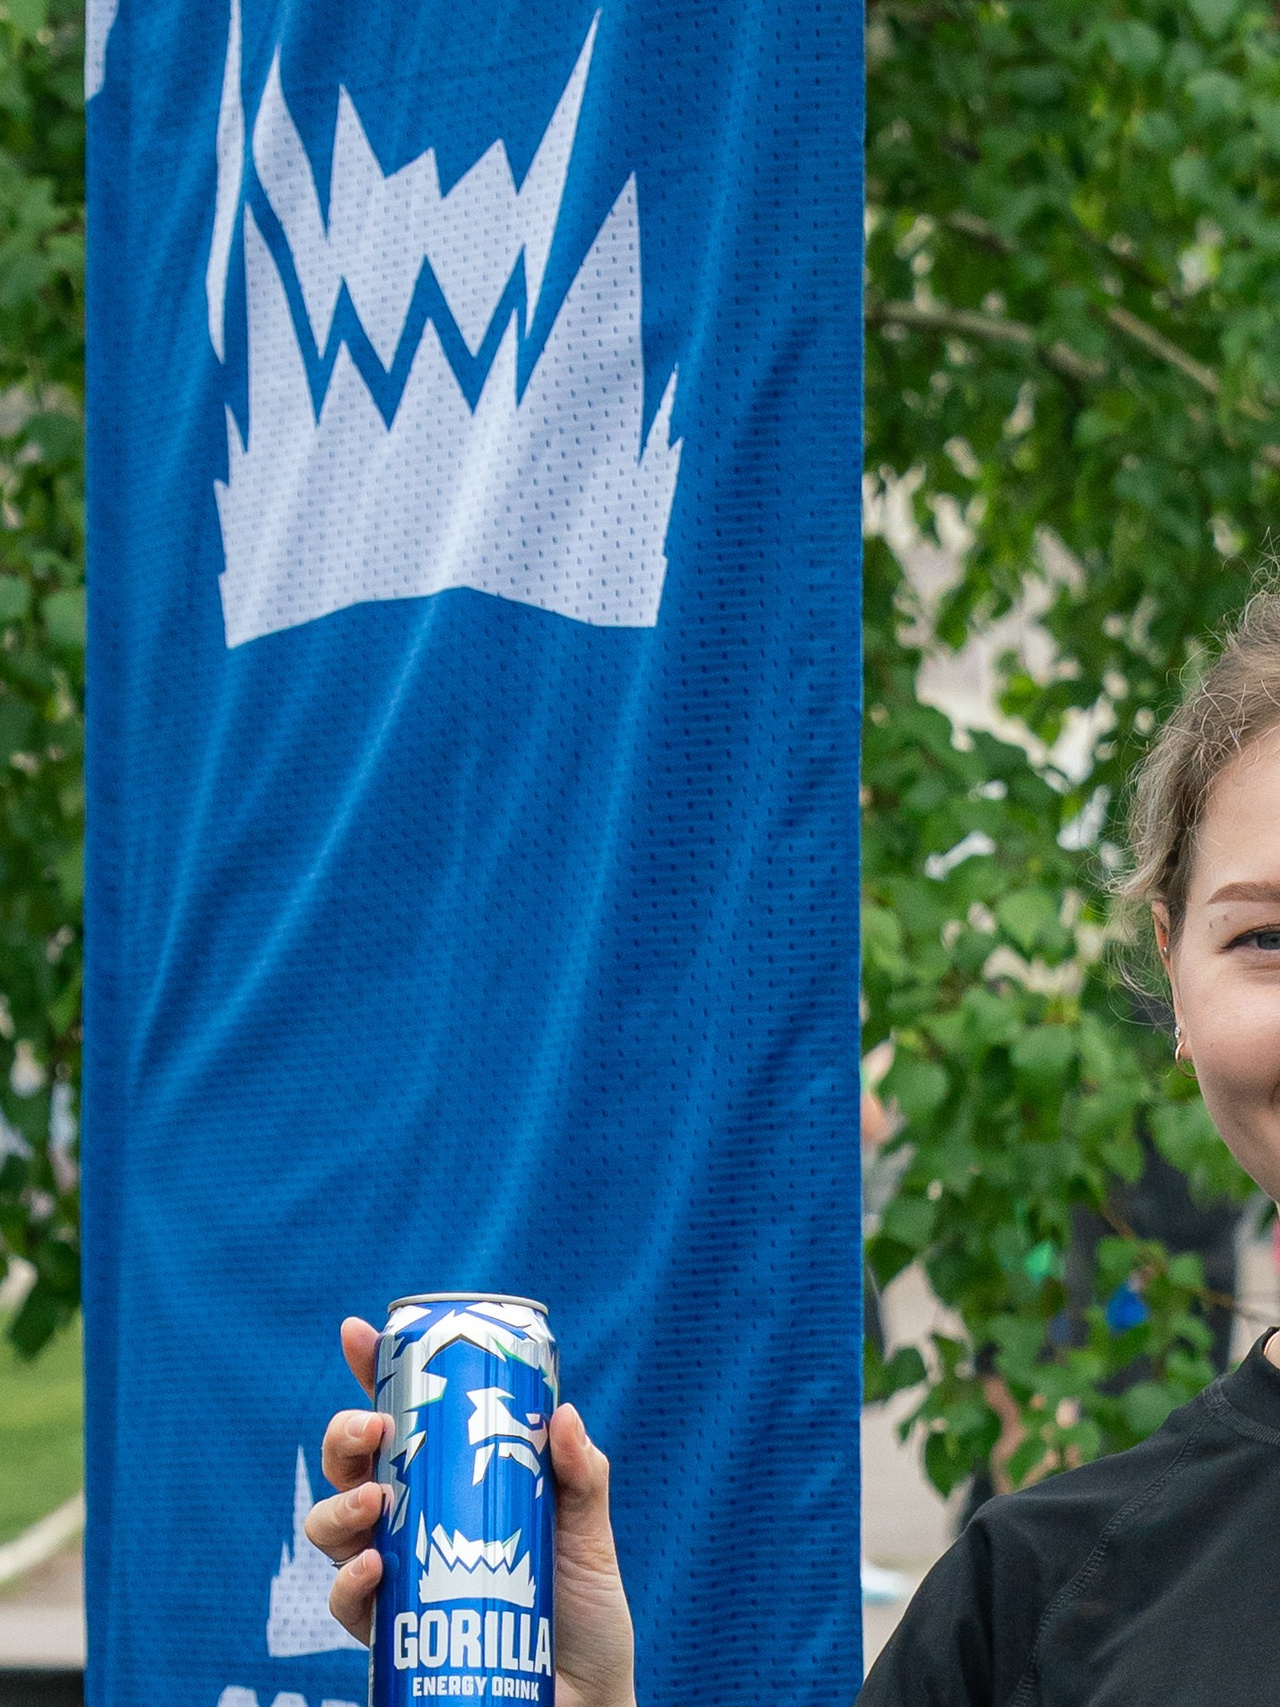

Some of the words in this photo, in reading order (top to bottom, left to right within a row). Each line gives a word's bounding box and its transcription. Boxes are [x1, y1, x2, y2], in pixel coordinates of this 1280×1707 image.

[393, 1609, 553, 1676] GORILLA
[412, 1675, 487, 1697] ENERGY
[491, 1675, 539, 1701] DRINK
